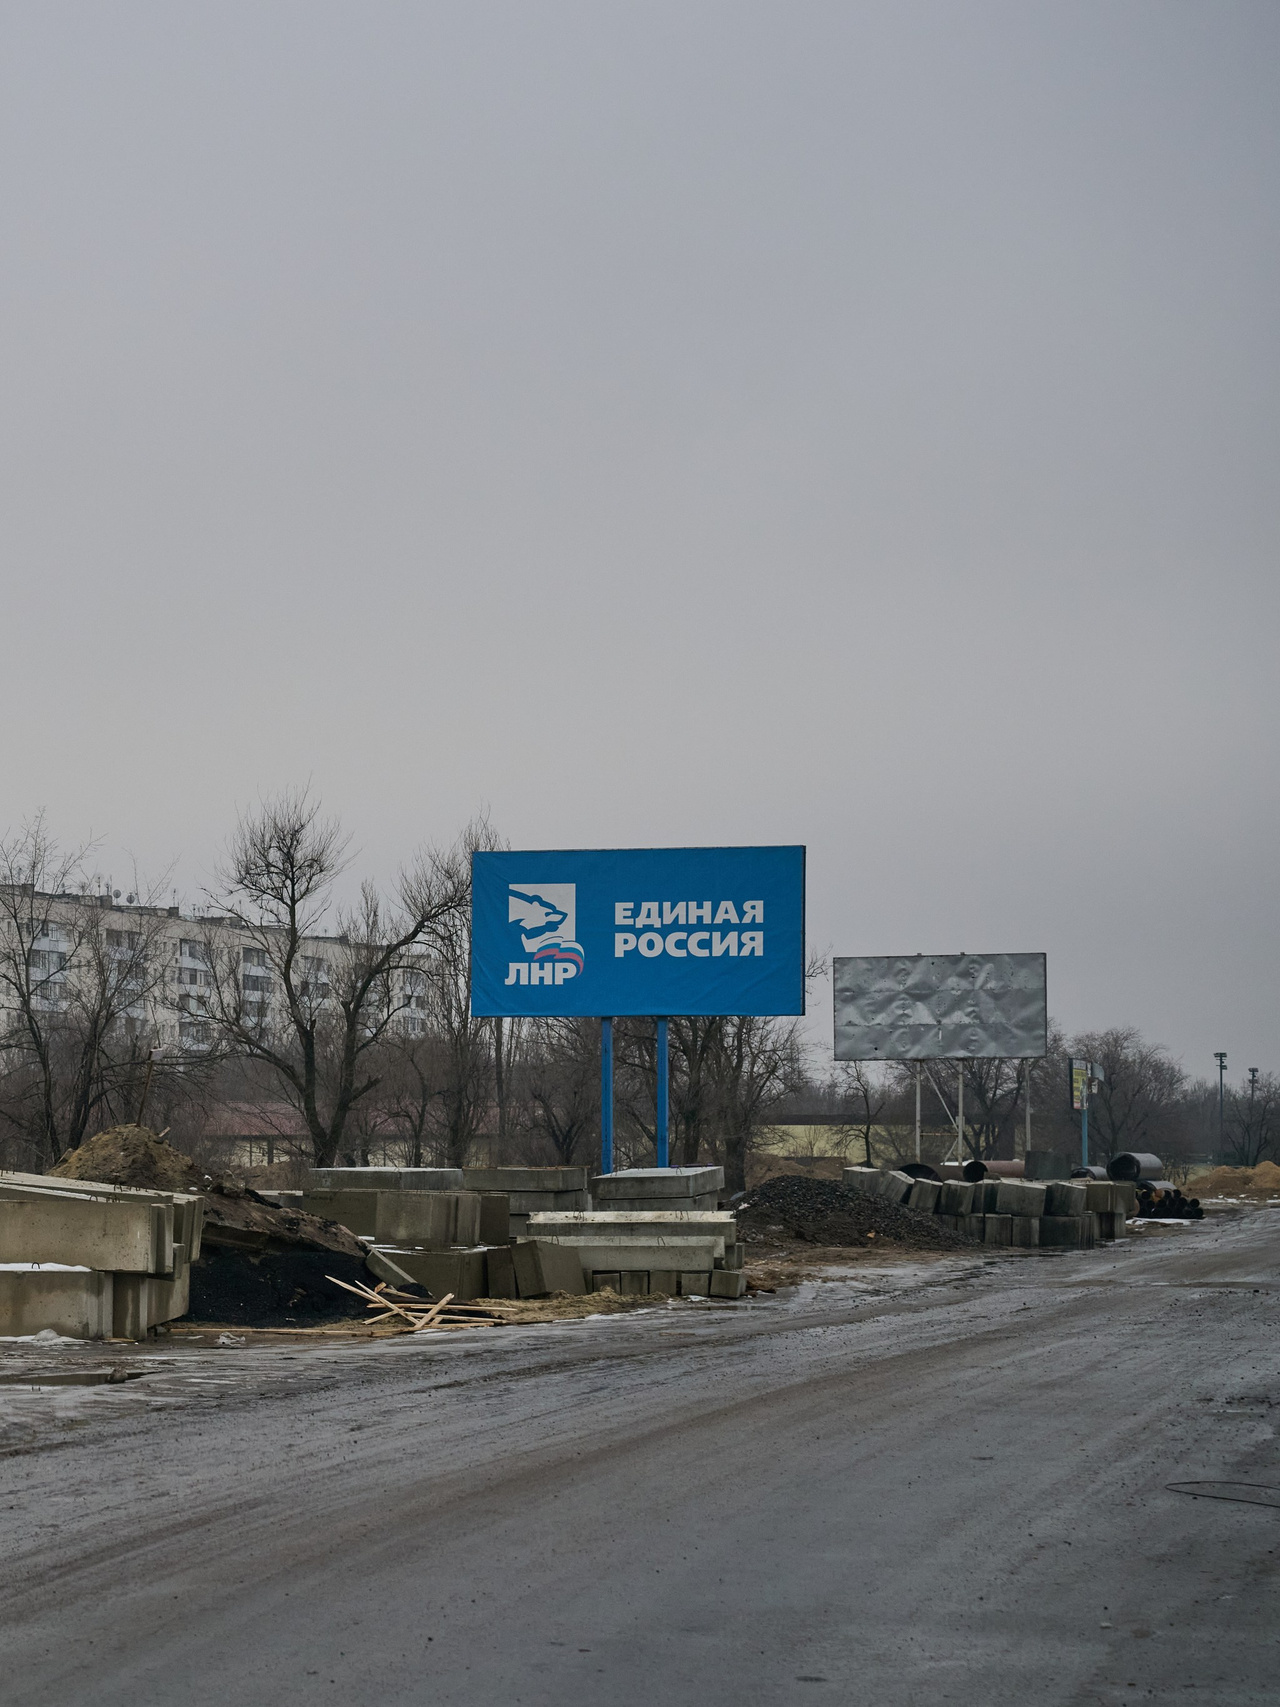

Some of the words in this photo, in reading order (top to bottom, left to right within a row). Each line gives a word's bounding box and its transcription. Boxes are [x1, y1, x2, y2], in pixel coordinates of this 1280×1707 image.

[615, 900, 764, 928] ЕДИНАЯ
[615, 931, 764, 958] РОССИЯ
[505, 962, 577, 986] ЛНР
